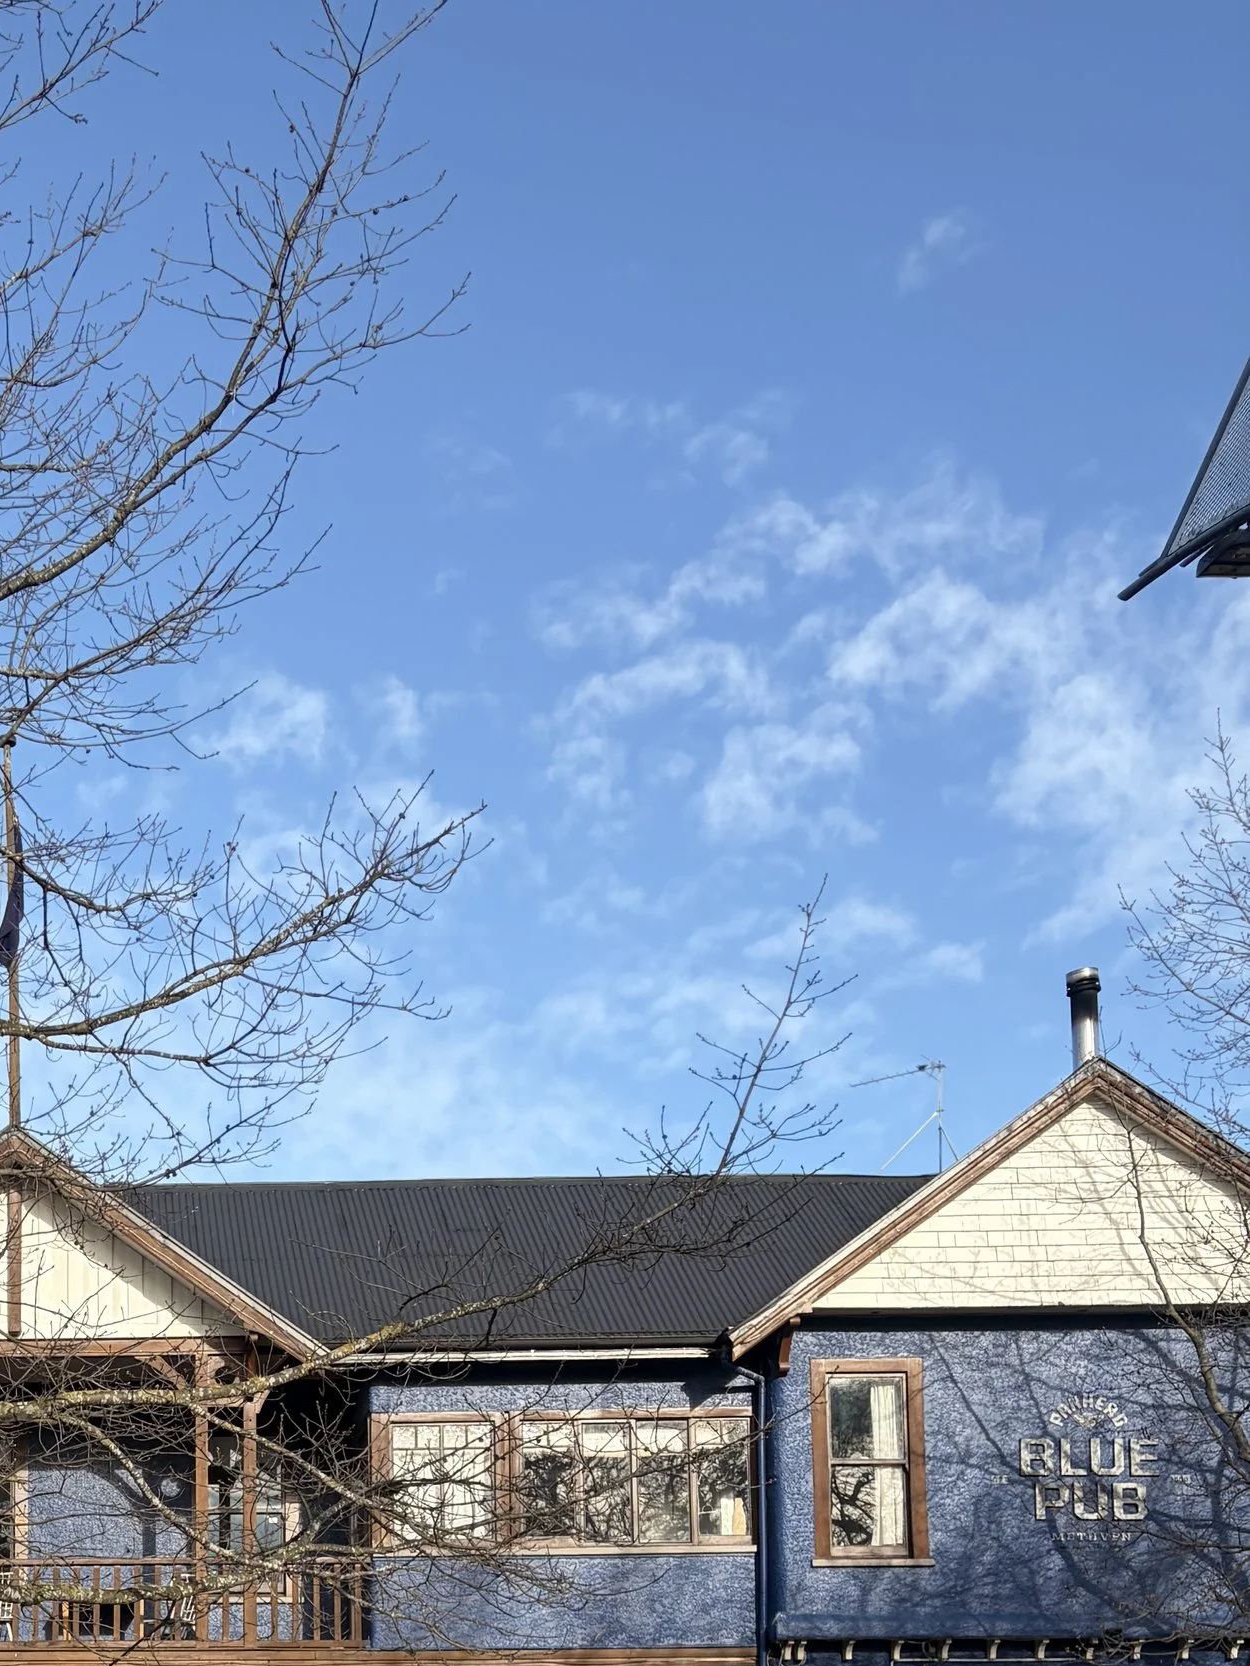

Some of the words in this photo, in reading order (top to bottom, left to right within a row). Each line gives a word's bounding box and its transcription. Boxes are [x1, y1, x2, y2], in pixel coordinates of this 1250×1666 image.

[1050, 1396, 1128, 1428] PANHEAD
[1019, 1438, 1160, 1477] BLUE
[1034, 1482, 1148, 1521] PUB
